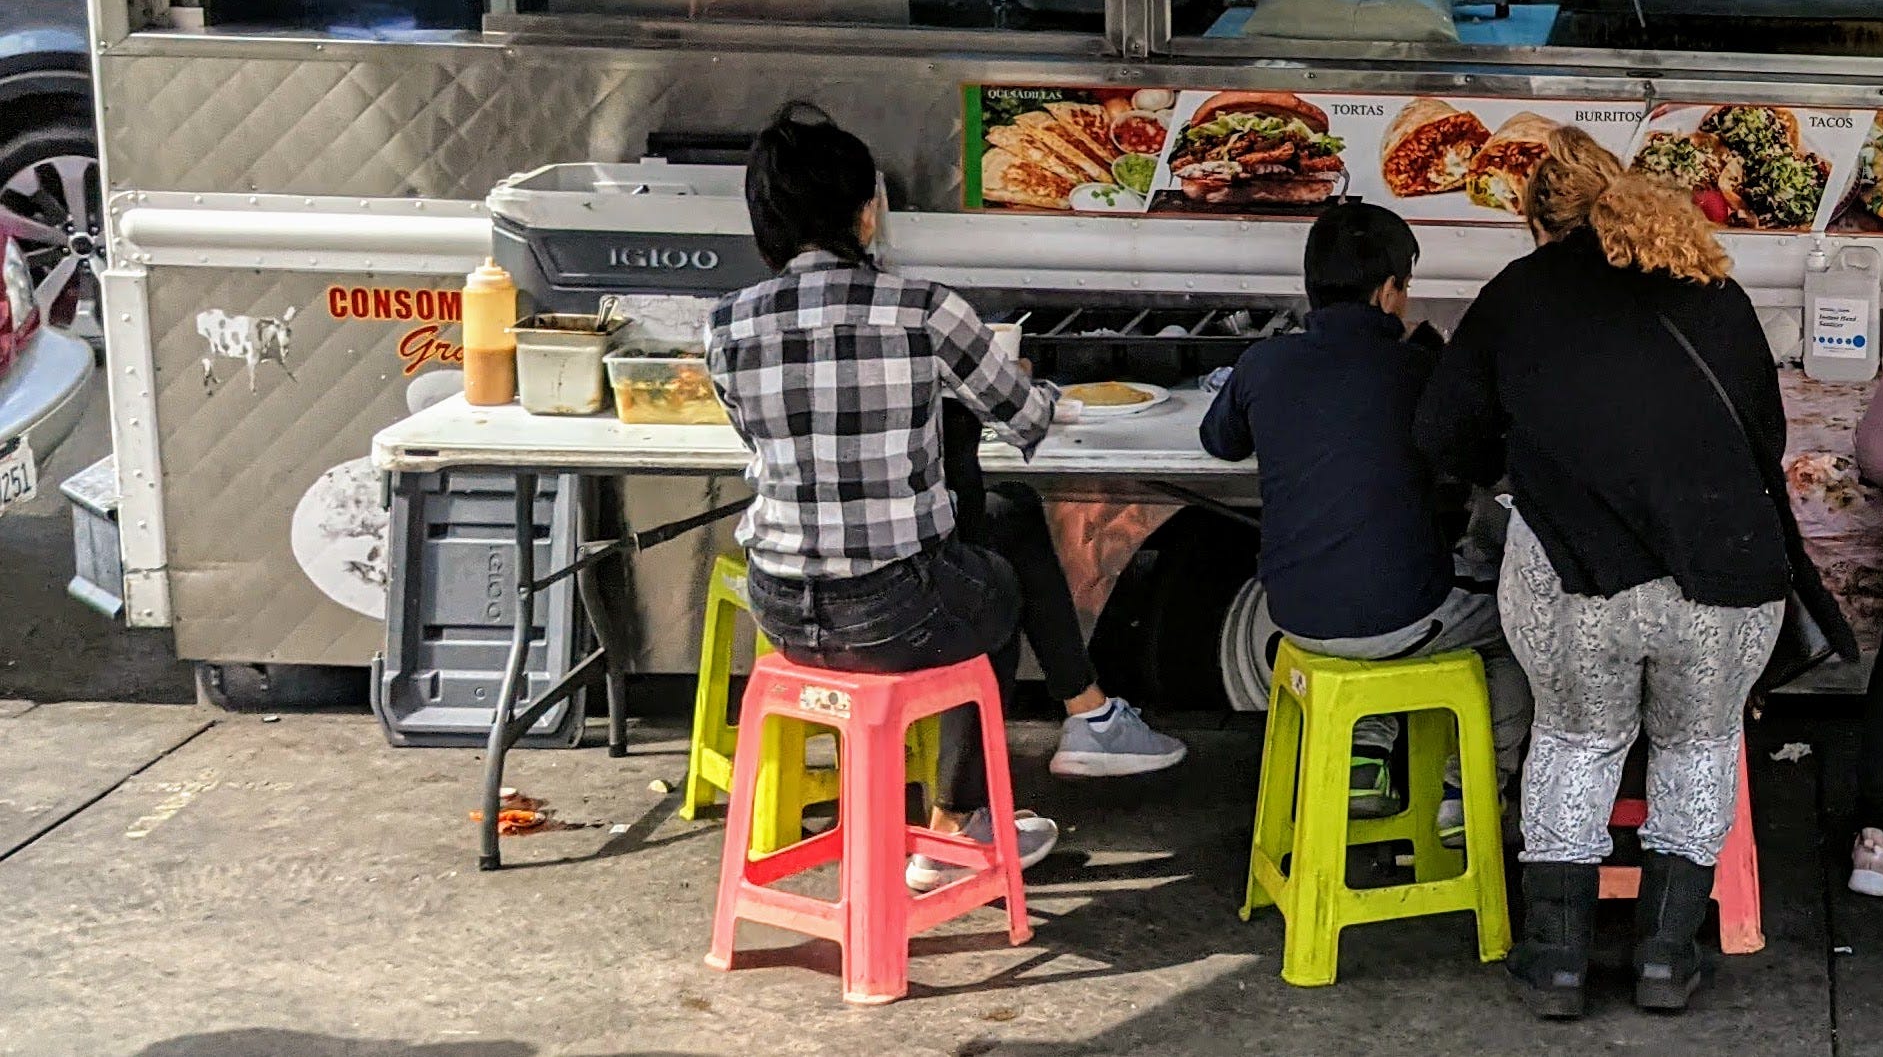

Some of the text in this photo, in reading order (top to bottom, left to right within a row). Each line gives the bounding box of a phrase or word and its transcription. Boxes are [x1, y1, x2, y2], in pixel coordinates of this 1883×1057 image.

[987, 88, 1063, 100] QUESADILLAS
[1331, 104, 1384, 116] TORTAS
[1575, 110, 1643, 124] BURRITOS
[1809, 115, 1853, 129] TACOS
[609, 248, 719, 270] IGLOO
[328, 286, 463, 322] CONSOM
